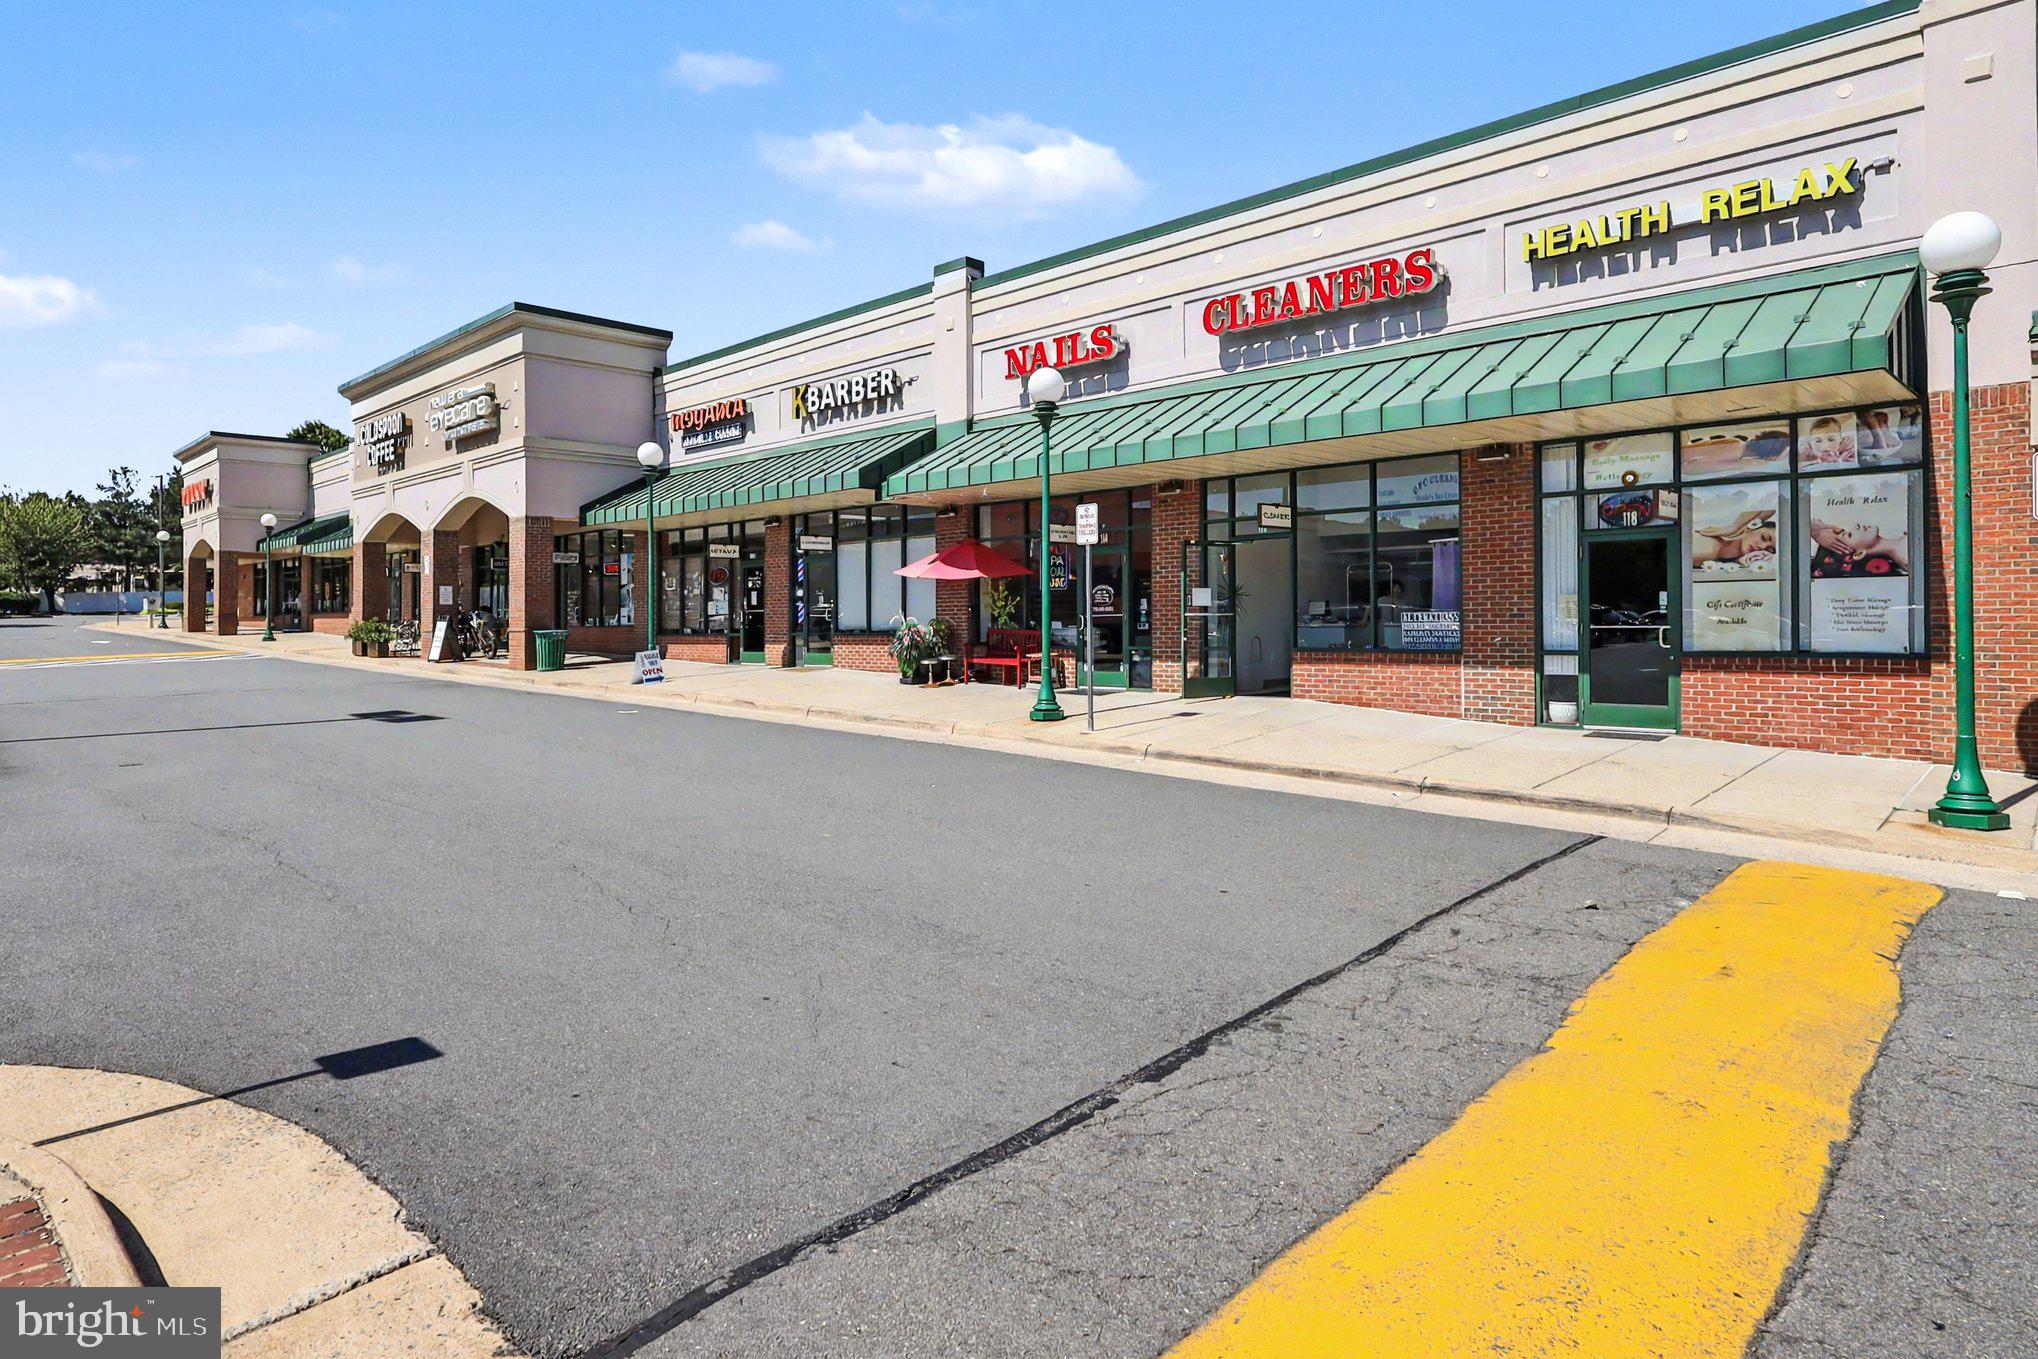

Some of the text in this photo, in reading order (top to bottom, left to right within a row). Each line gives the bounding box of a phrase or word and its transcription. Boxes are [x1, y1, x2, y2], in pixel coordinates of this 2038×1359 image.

[1522, 157, 1859, 263] HEALTH RELAX
[1202, 248, 1436, 337] CLEANERS
[1004, 324, 1117, 380] NAILS
[368, 438, 395, 467] COFFEE
[1622, 510, 1638, 527] 118
[642, 667, 664, 676] OPEN
